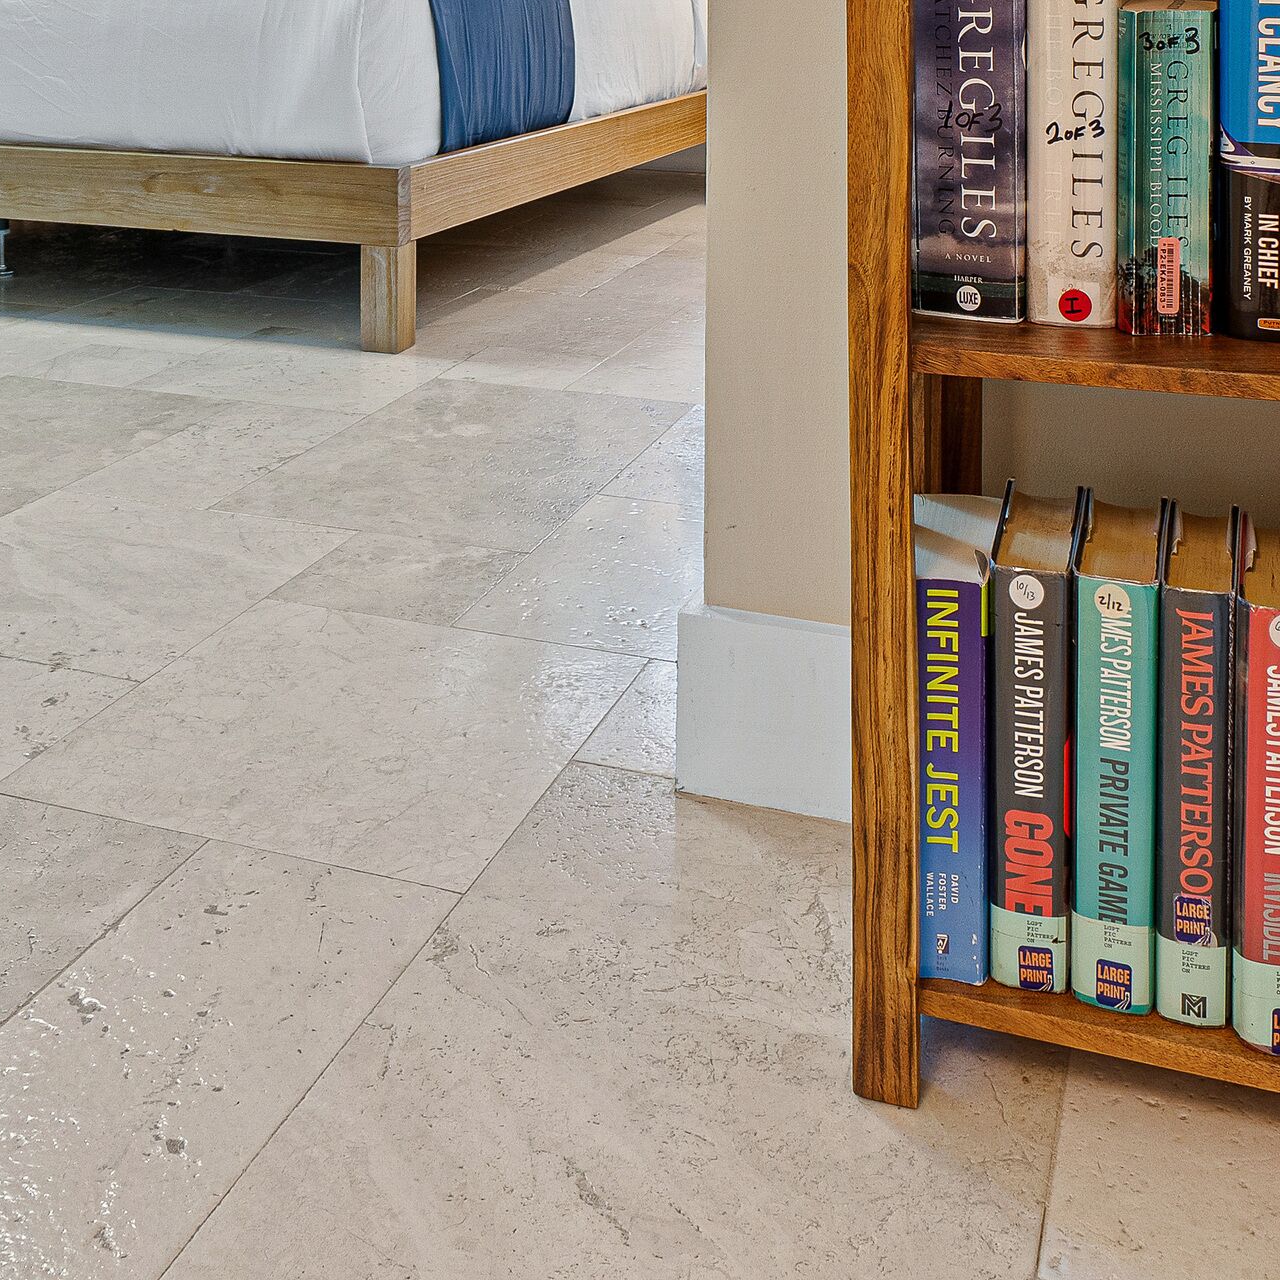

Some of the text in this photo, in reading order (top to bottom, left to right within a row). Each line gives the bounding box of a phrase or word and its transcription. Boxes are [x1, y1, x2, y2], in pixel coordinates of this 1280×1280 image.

[1139, 31, 1153, 52] 3
[1185, 27, 1200, 54] 3
[986, 103, 1002, 133] 3
[1046, 119, 1105, 145] 2 3
[1150, 63, 1162, 247] MISSISSIPPI BLOOD
[1166, 60, 1189, 248] GREG ILES
[960, 133, 997, 238] ILES
[1071, 149, 1103, 258] ILES
[956, 254, 992, 263] NOVEL
[1243, 196, 1252, 301] BY MARK GREANEY
[1258, 214, 1279, 289] IN CHIEF
[954, 275, 983, 283] HARPER
[959, 291, 978, 305] LUXE
[1016, 581, 1035, 601] 10/13
[1099, 657, 1131, 752] PATTERSON
[926, 589, 959, 854] INFINITE JEST
[1004, 612, 1054, 917] JAMES PATTERSON GONE
[1176, 608, 1214, 902] JAMES PATTERSO
[1098, 757, 1130, 858] PRIVATE
[926, 872, 934, 917] WALLACE
[938, 873, 947, 910] FOSTER
[951, 874, 959, 904] DAVID
[1176, 901, 1209, 919] LARGE
[1177, 919, 1206, 935] PRINT
[1020, 951, 1051, 967] LARGE
[1097, 964, 1130, 984] LARGE
[1021, 968, 1048, 983] PRINT
[1098, 982, 1125, 1000] PRINT
